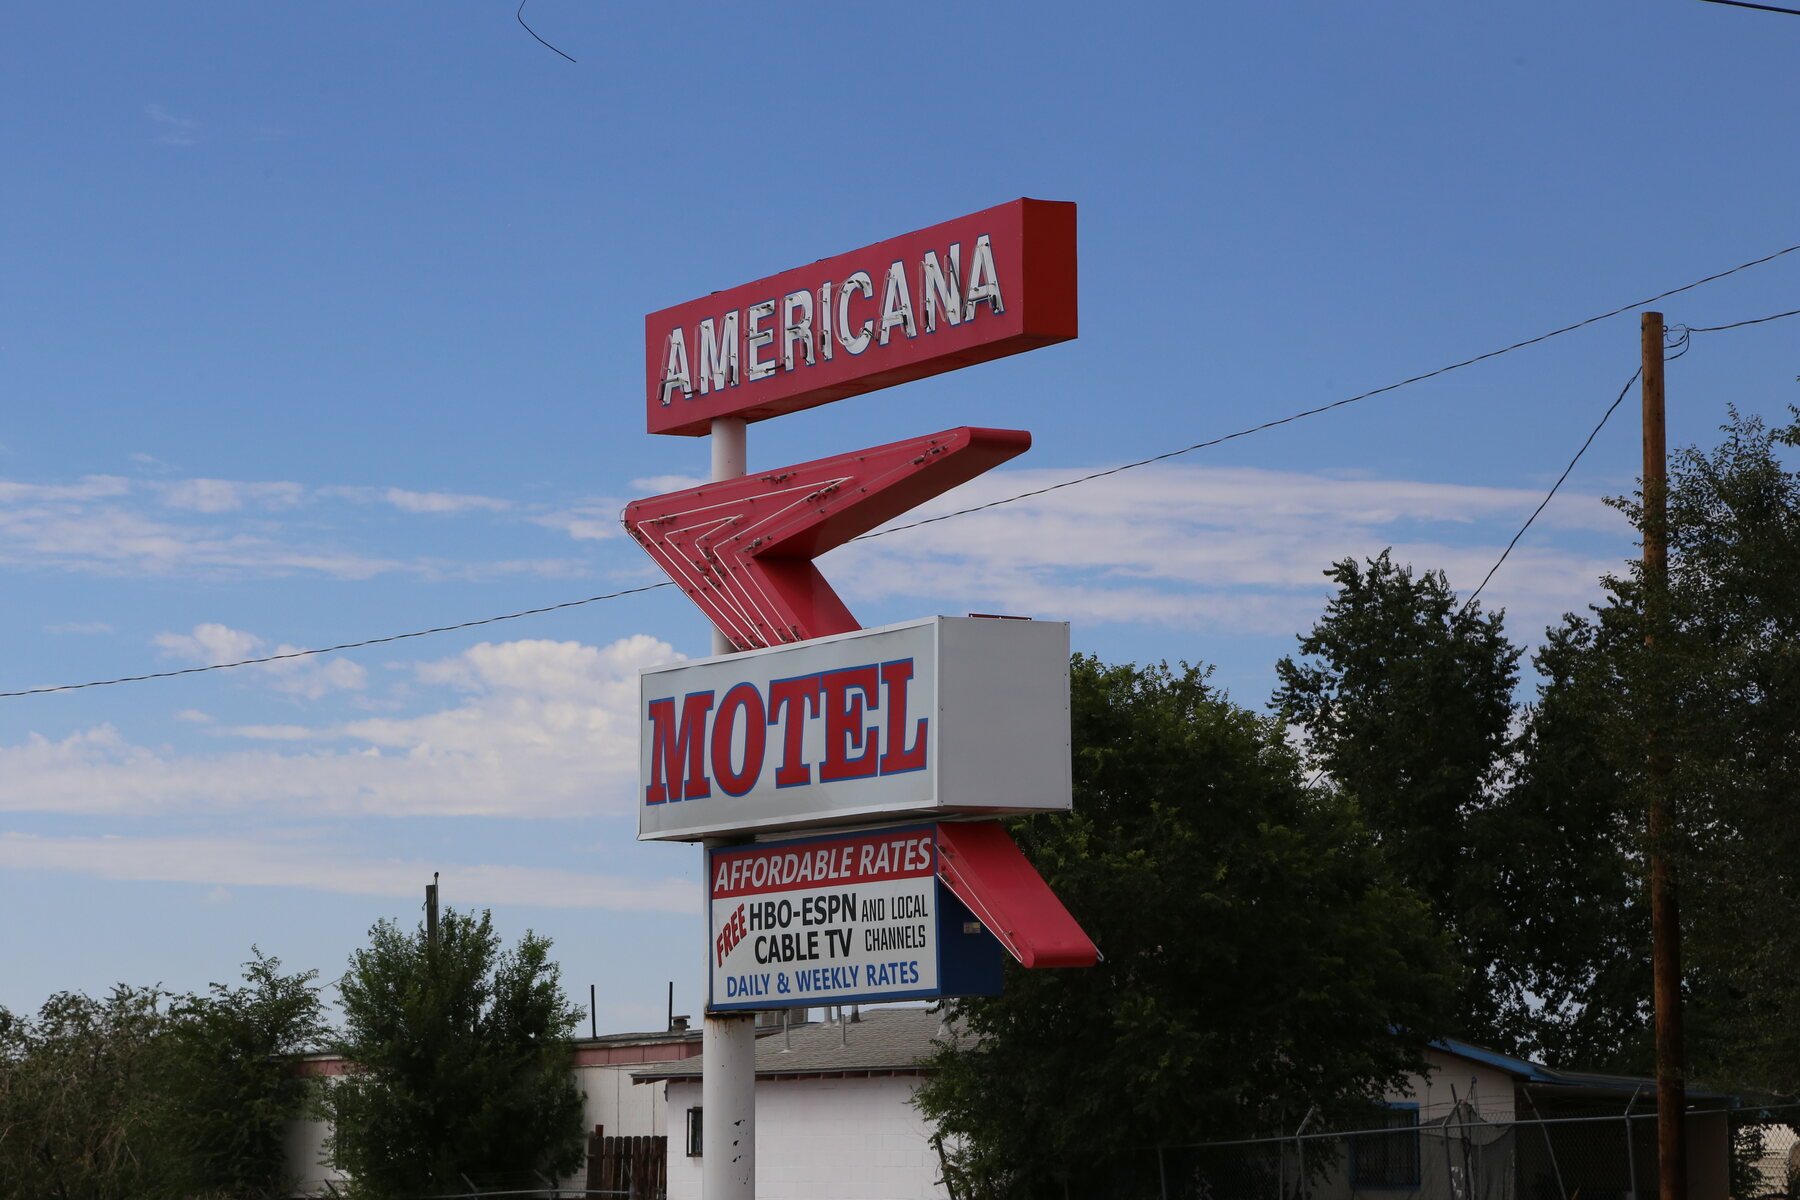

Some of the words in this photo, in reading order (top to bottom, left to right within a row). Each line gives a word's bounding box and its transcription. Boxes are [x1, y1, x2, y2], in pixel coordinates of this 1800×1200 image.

[657, 233, 1005, 407] AMERICANA
[645, 657, 929, 806] MOTEL
[714, 847, 854, 893] AFFORDABLE
[858, 837, 932, 876] RATES
[716, 903, 747, 968] FREE
[749, 893, 857, 931] HBO-ESPN
[861, 898, 885, 922] AND
[891, 894, 928, 920] LOCAL
[754, 931, 819, 964] CABLE
[825, 928, 853, 958] TV
[865, 924, 926, 952] CHANNELS
[727, 973, 770, 998] DAILY
[777, 972, 791, 994] &
[795, 965, 859, 992] WEEKLY
[866, 960, 919, 986] RATES
